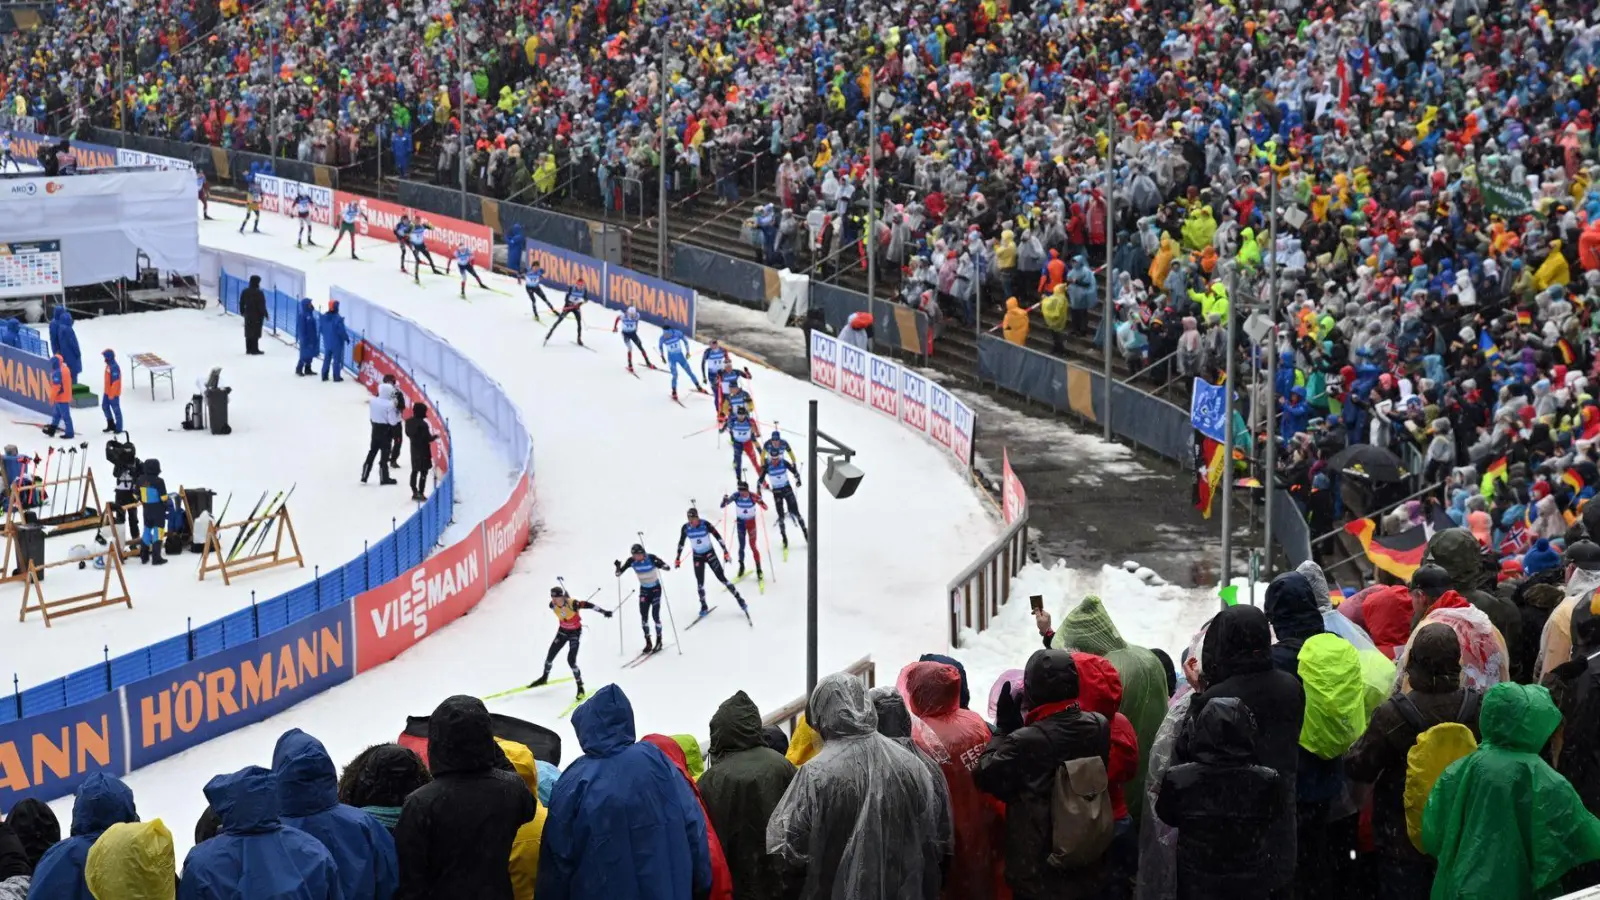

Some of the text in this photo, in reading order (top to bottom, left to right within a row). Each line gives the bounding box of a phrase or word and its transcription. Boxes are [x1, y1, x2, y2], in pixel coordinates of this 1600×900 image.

[609, 272, 689, 327] HÖRMANN
[871, 357, 897, 391] LIQUI
[871, 382, 897, 416] MOLY
[370, 549, 479, 639] VIESSMANN
[141, 621, 344, 749] HÖRMANN
